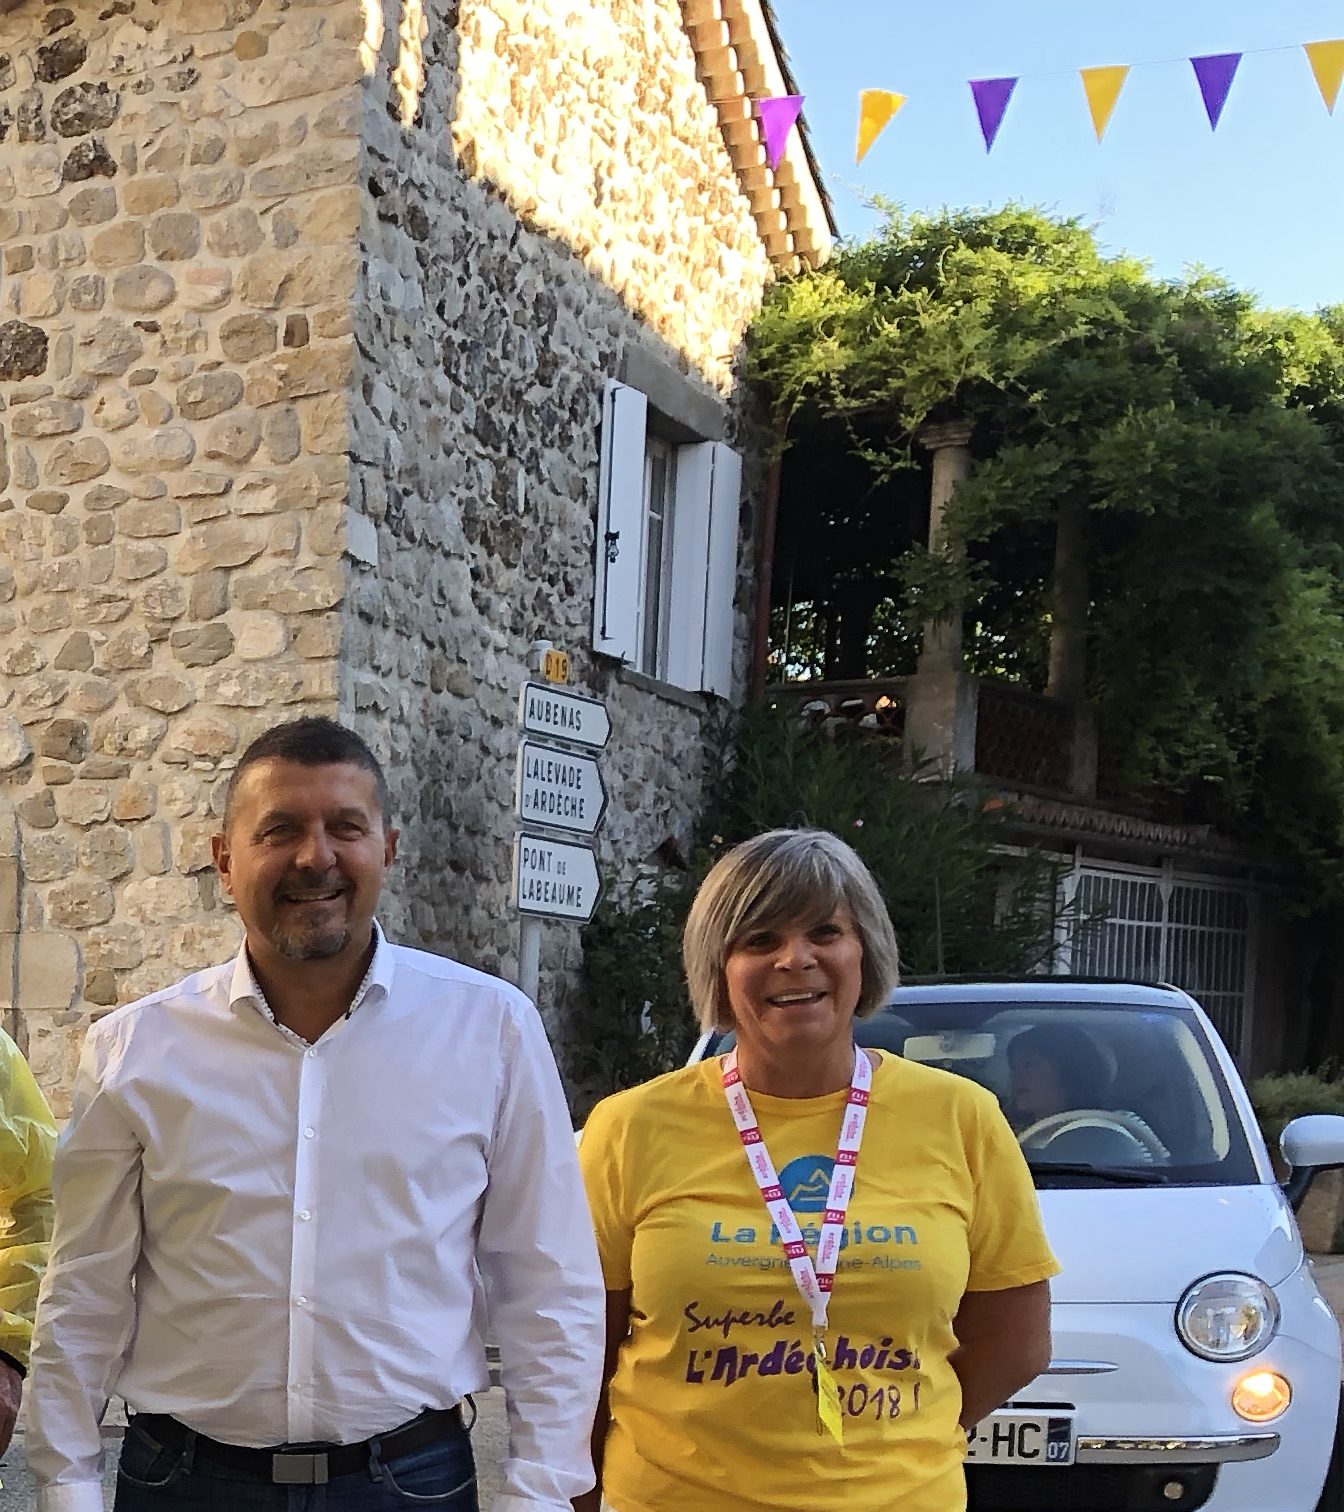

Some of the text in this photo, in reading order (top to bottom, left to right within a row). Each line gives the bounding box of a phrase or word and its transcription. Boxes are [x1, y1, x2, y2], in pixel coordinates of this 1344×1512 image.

[528, 697, 582, 731] AUBENAS
[526, 756, 583, 790] LALEVADE
[523, 847, 552, 873] PONT
[522, 877, 583, 908] LABEAUME
[711, 1221, 756, 1244] La
[684, 1299, 796, 1339] Superbe
[1048, 1441, 1070, 1459] 07
